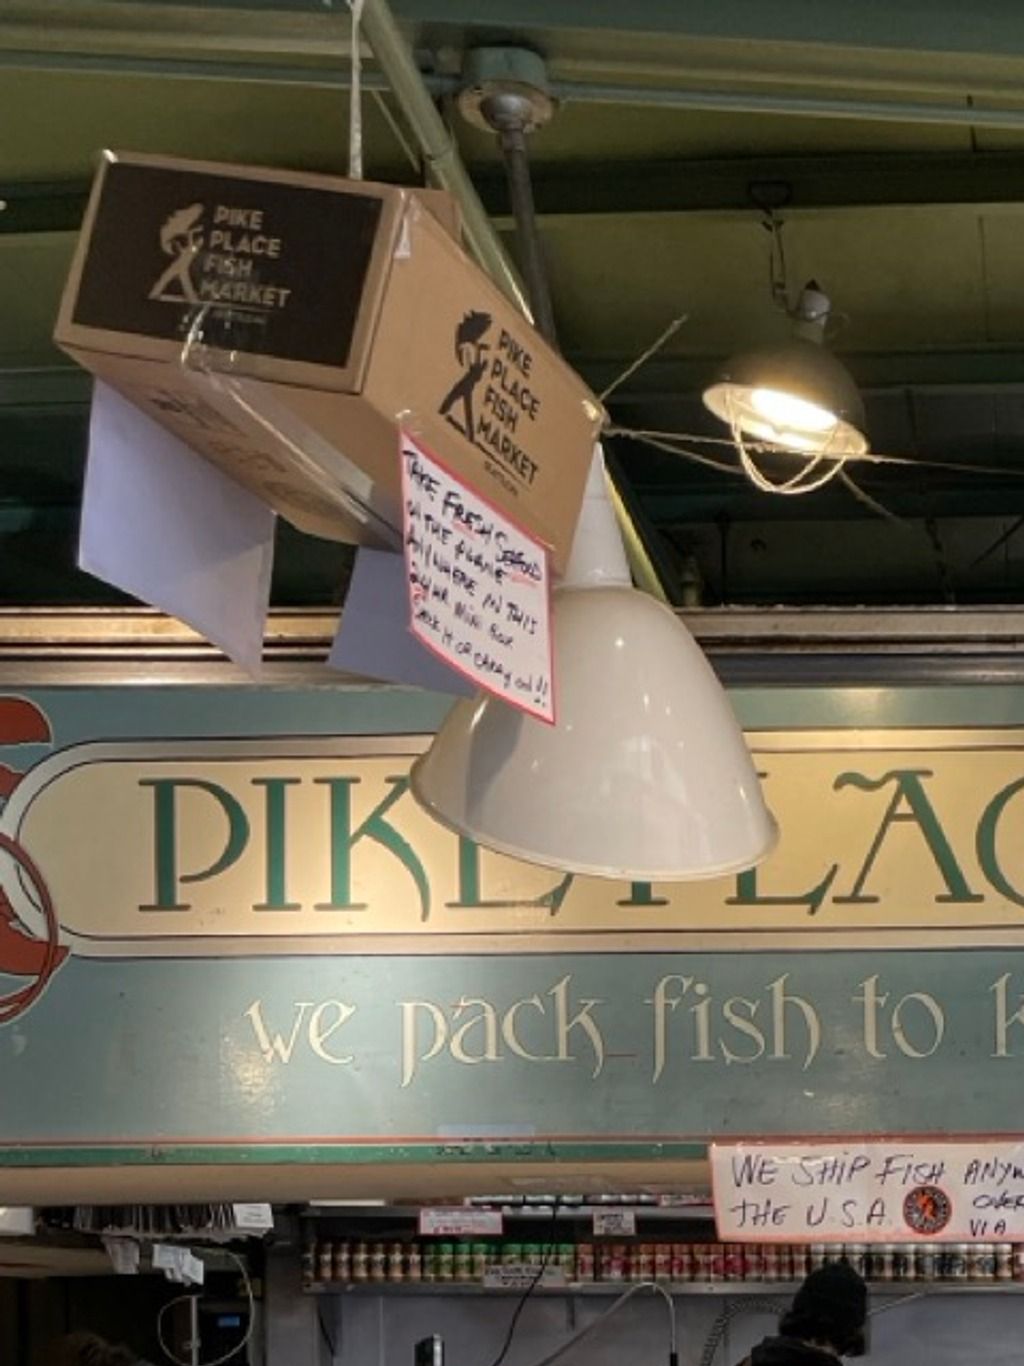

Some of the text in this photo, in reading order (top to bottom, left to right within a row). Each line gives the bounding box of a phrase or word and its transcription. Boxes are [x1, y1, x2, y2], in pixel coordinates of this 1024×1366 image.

[213, 205, 264, 231] PIKE
[209, 230, 281, 259] PLACE
[499, 328, 534, 379] PIKE
[484, 383, 519, 434] FISH
[490, 358, 540, 421] PLACE
[477, 414, 539, 485] MARKET
[243, 1000, 356, 1064] we
[401, 972, 605, 1088] pack
[652, 972, 822, 1083] fish
[853, 972, 947, 1059] to
[731, 1154, 778, 1187] WE
[875, 1153, 946, 1185] FISH
[970, 1218, 1007, 1238] VIA
